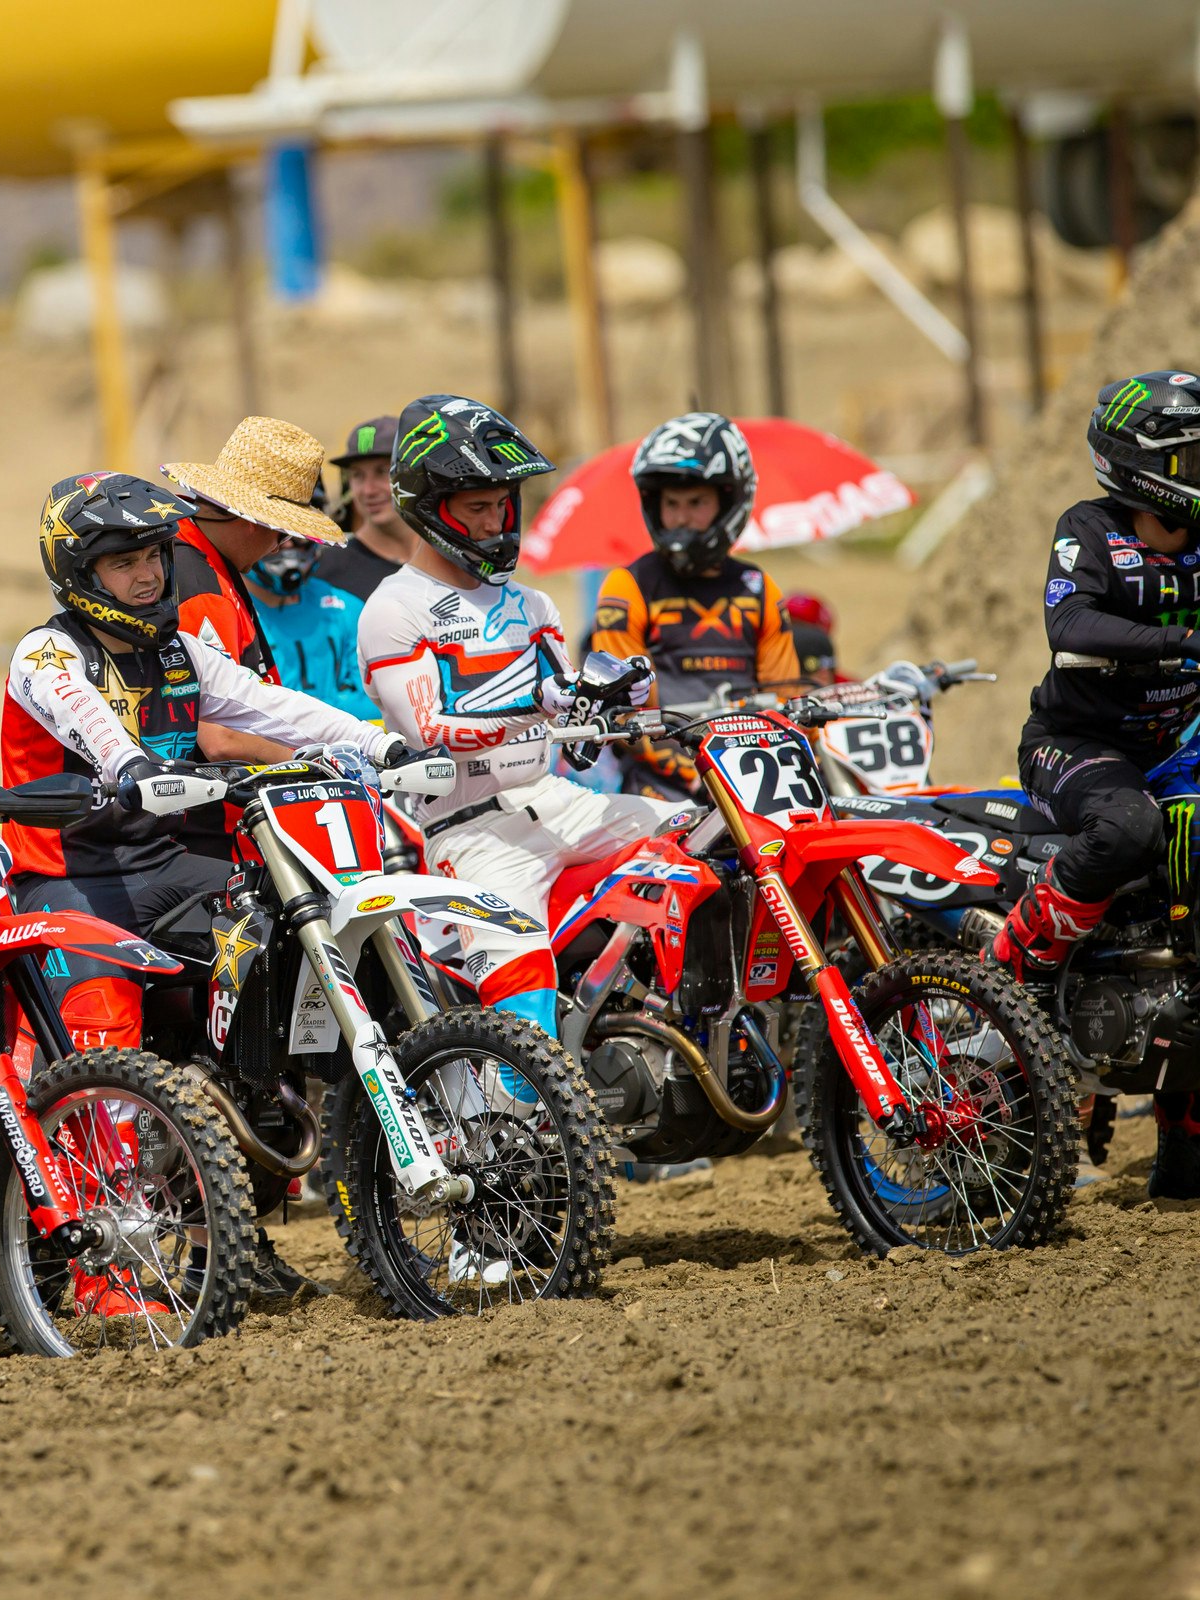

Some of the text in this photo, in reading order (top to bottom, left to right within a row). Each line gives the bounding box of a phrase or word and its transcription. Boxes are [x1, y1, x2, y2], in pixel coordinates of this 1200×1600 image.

[507, 463, 548, 474] MONSTER
[1131, 475, 1187, 507] MONSTER
[734, 470, 913, 552] ASGAS
[137, 529, 156, 539] ENERGY
[1113, 552, 1138, 565] 100%
[67, 591, 158, 639] ROCKSTAR
[433, 616, 475, 627] HONDA
[647, 596, 763, 642] FXR
[439, 628, 479, 646] SHOWA
[1145, 681, 1198, 703] YAMALUBE
[139, 701, 196, 728] FLY
[508, 722, 547, 745] NDA
[715, 721, 768, 732] RENTHAL
[767, 733, 783, 743] OIL
[845, 720, 925, 772] 58
[427, 765, 454, 778] PROTAPER
[506, 758, 536, 769] DUNLOP
[155, 781, 184, 796] PROTAPER
[328, 787, 344, 797] OIL
[739, 746, 823, 817] 23
[985, 802, 1018, 820] YAMAHA
[314, 802, 359, 868] 1
[614, 859, 701, 880] CRF
[447, 901, 491, 918] ROCKSTAR
[760, 885, 810, 961] SHOWA
[474, 960, 497, 982] NDA
[911, 975, 971, 994] DUNLOP
[71, 1030, 108, 1046] FLY
[830, 998, 888, 1087] DUNLOP
[382, 1068, 430, 1158] DUNLOP
[373, 1091, 412, 1166] MOTOREX
[43, 1156, 68, 1202] OAKLEY
